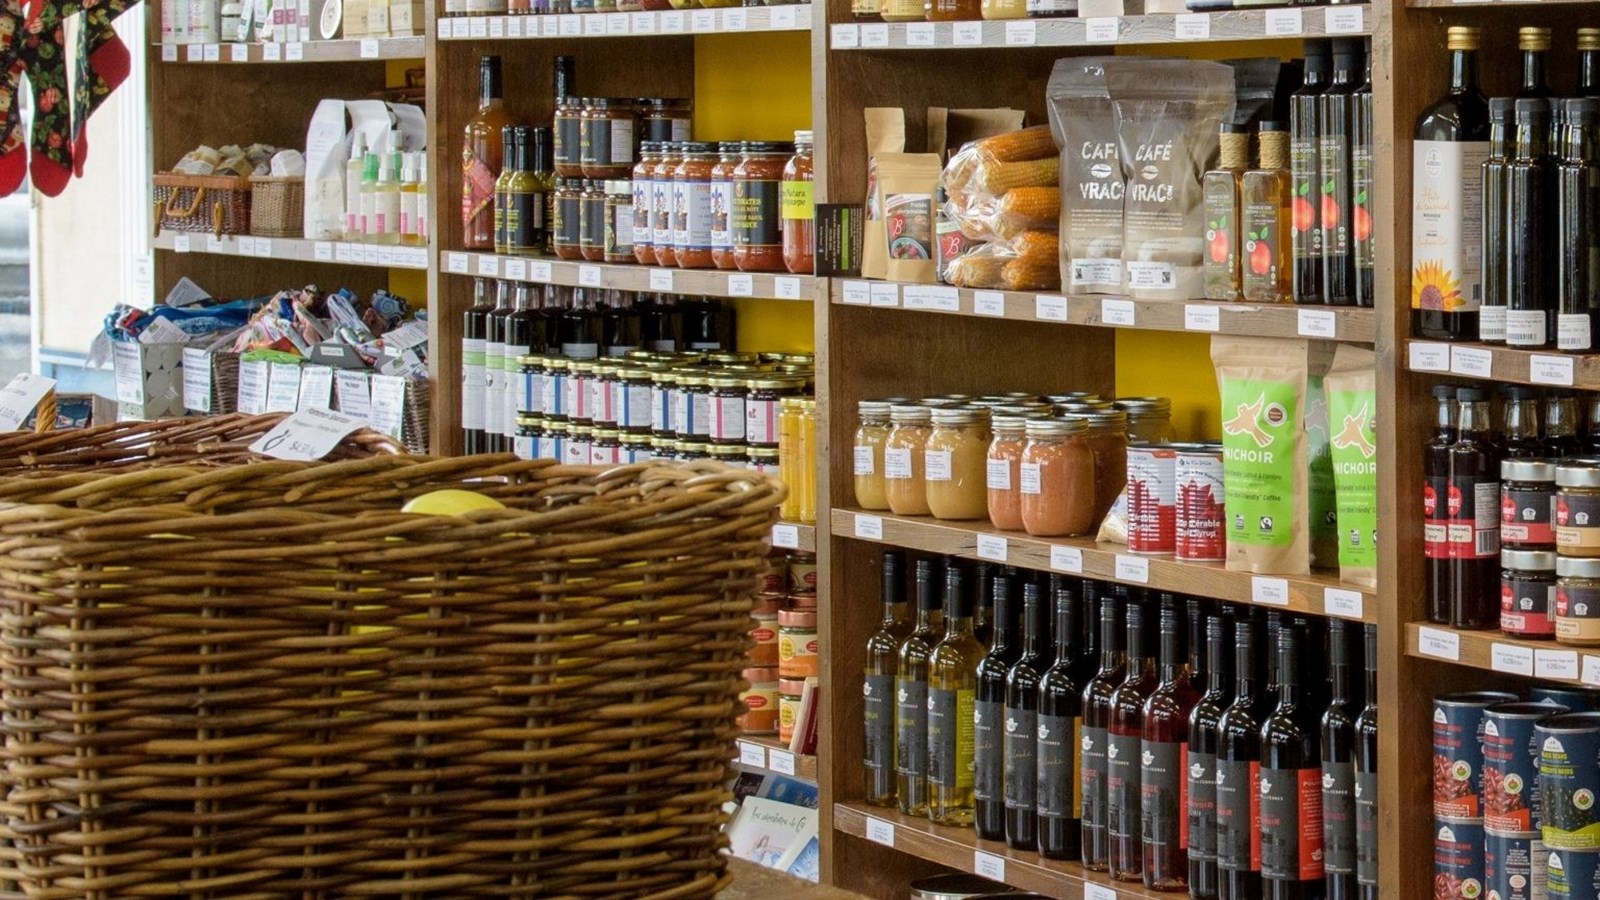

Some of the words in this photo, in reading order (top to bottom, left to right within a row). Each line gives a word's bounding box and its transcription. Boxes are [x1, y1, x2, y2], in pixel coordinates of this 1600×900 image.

[1135, 139, 1173, 161] CAFÉ
[1080, 182, 1121, 200] VRAC
[1132, 184, 1166, 202] VRAC
[1224, 447, 1273, 463] NICHOIR
